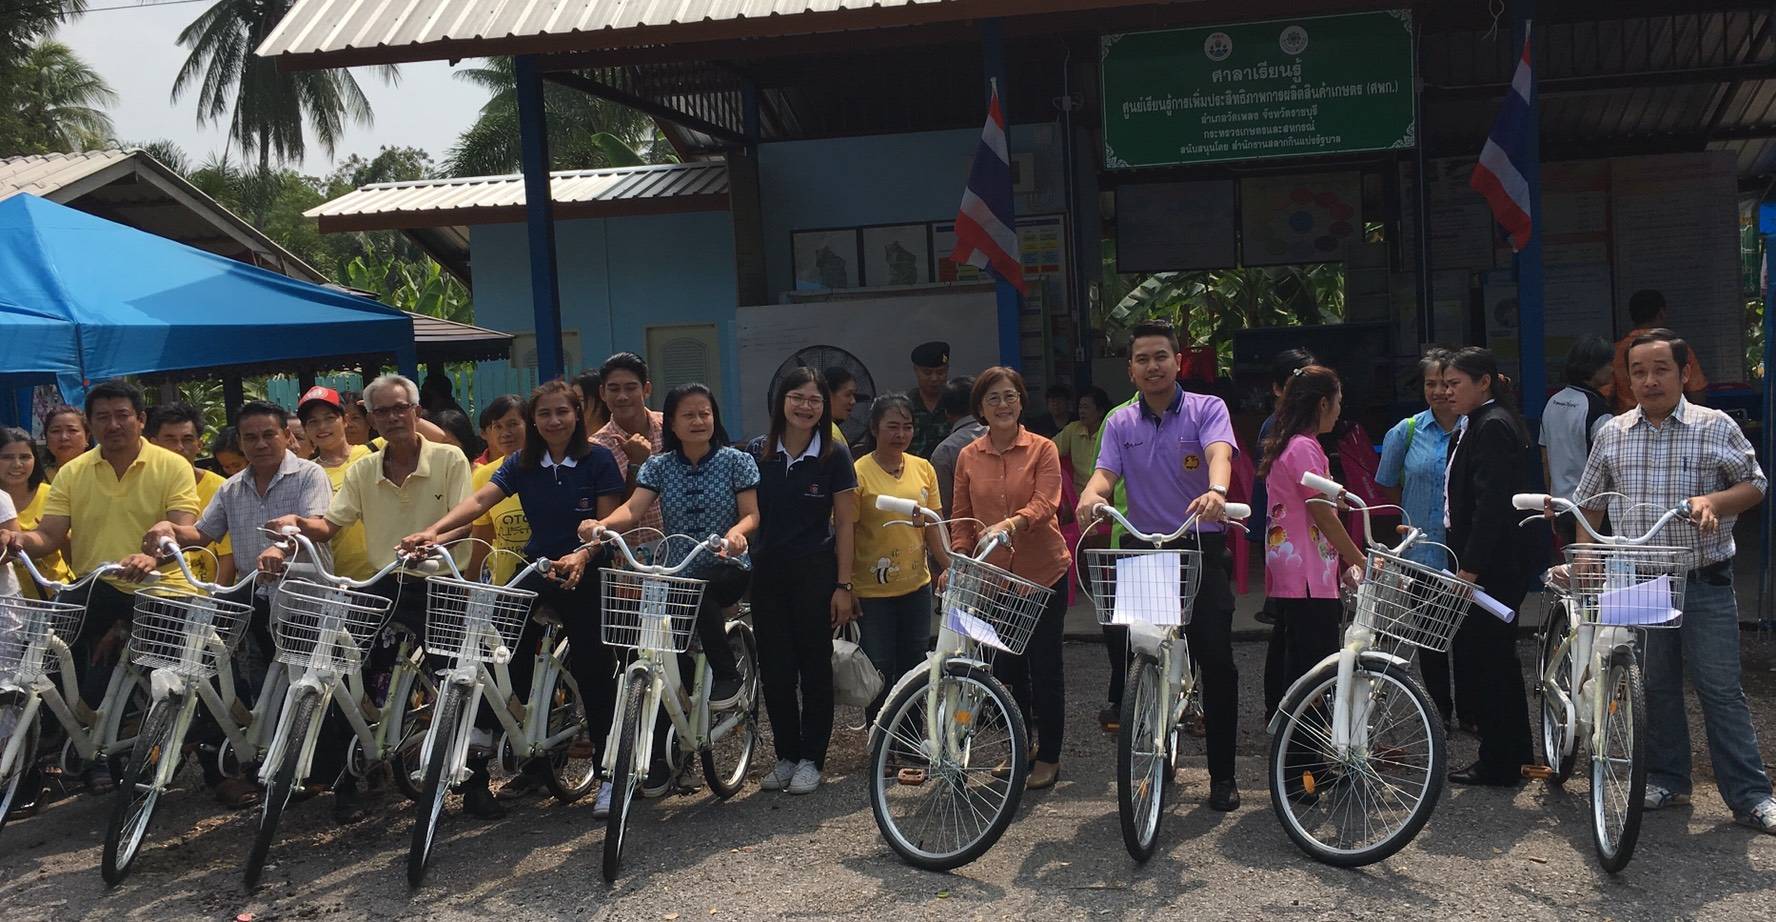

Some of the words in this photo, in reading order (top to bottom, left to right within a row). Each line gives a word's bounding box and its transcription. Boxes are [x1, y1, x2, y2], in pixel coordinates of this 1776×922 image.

[1211, 57, 1303, 83] ศาลาเรียนรู้
[1122, 82, 1363, 119] ศูนย์เรียนรู้การเพิ่มประสิทธิภาพการผลิตสินค้าเกษตร
[1367, 79, 1399, 96] (ศพก.)
[1200, 111, 1259, 124] อำเภอวัดเพลง
[1262, 104, 1318, 120] จังหวัดราชบุรี
[1204, 120, 1316, 139] กระทรวงเกษตรและสหกรณ์
[1180, 141, 1229, 155] สนับสนุนโดย
[1232, 134, 1342, 150] สำนักงานสลากกินแบ่งรัฐบาล
